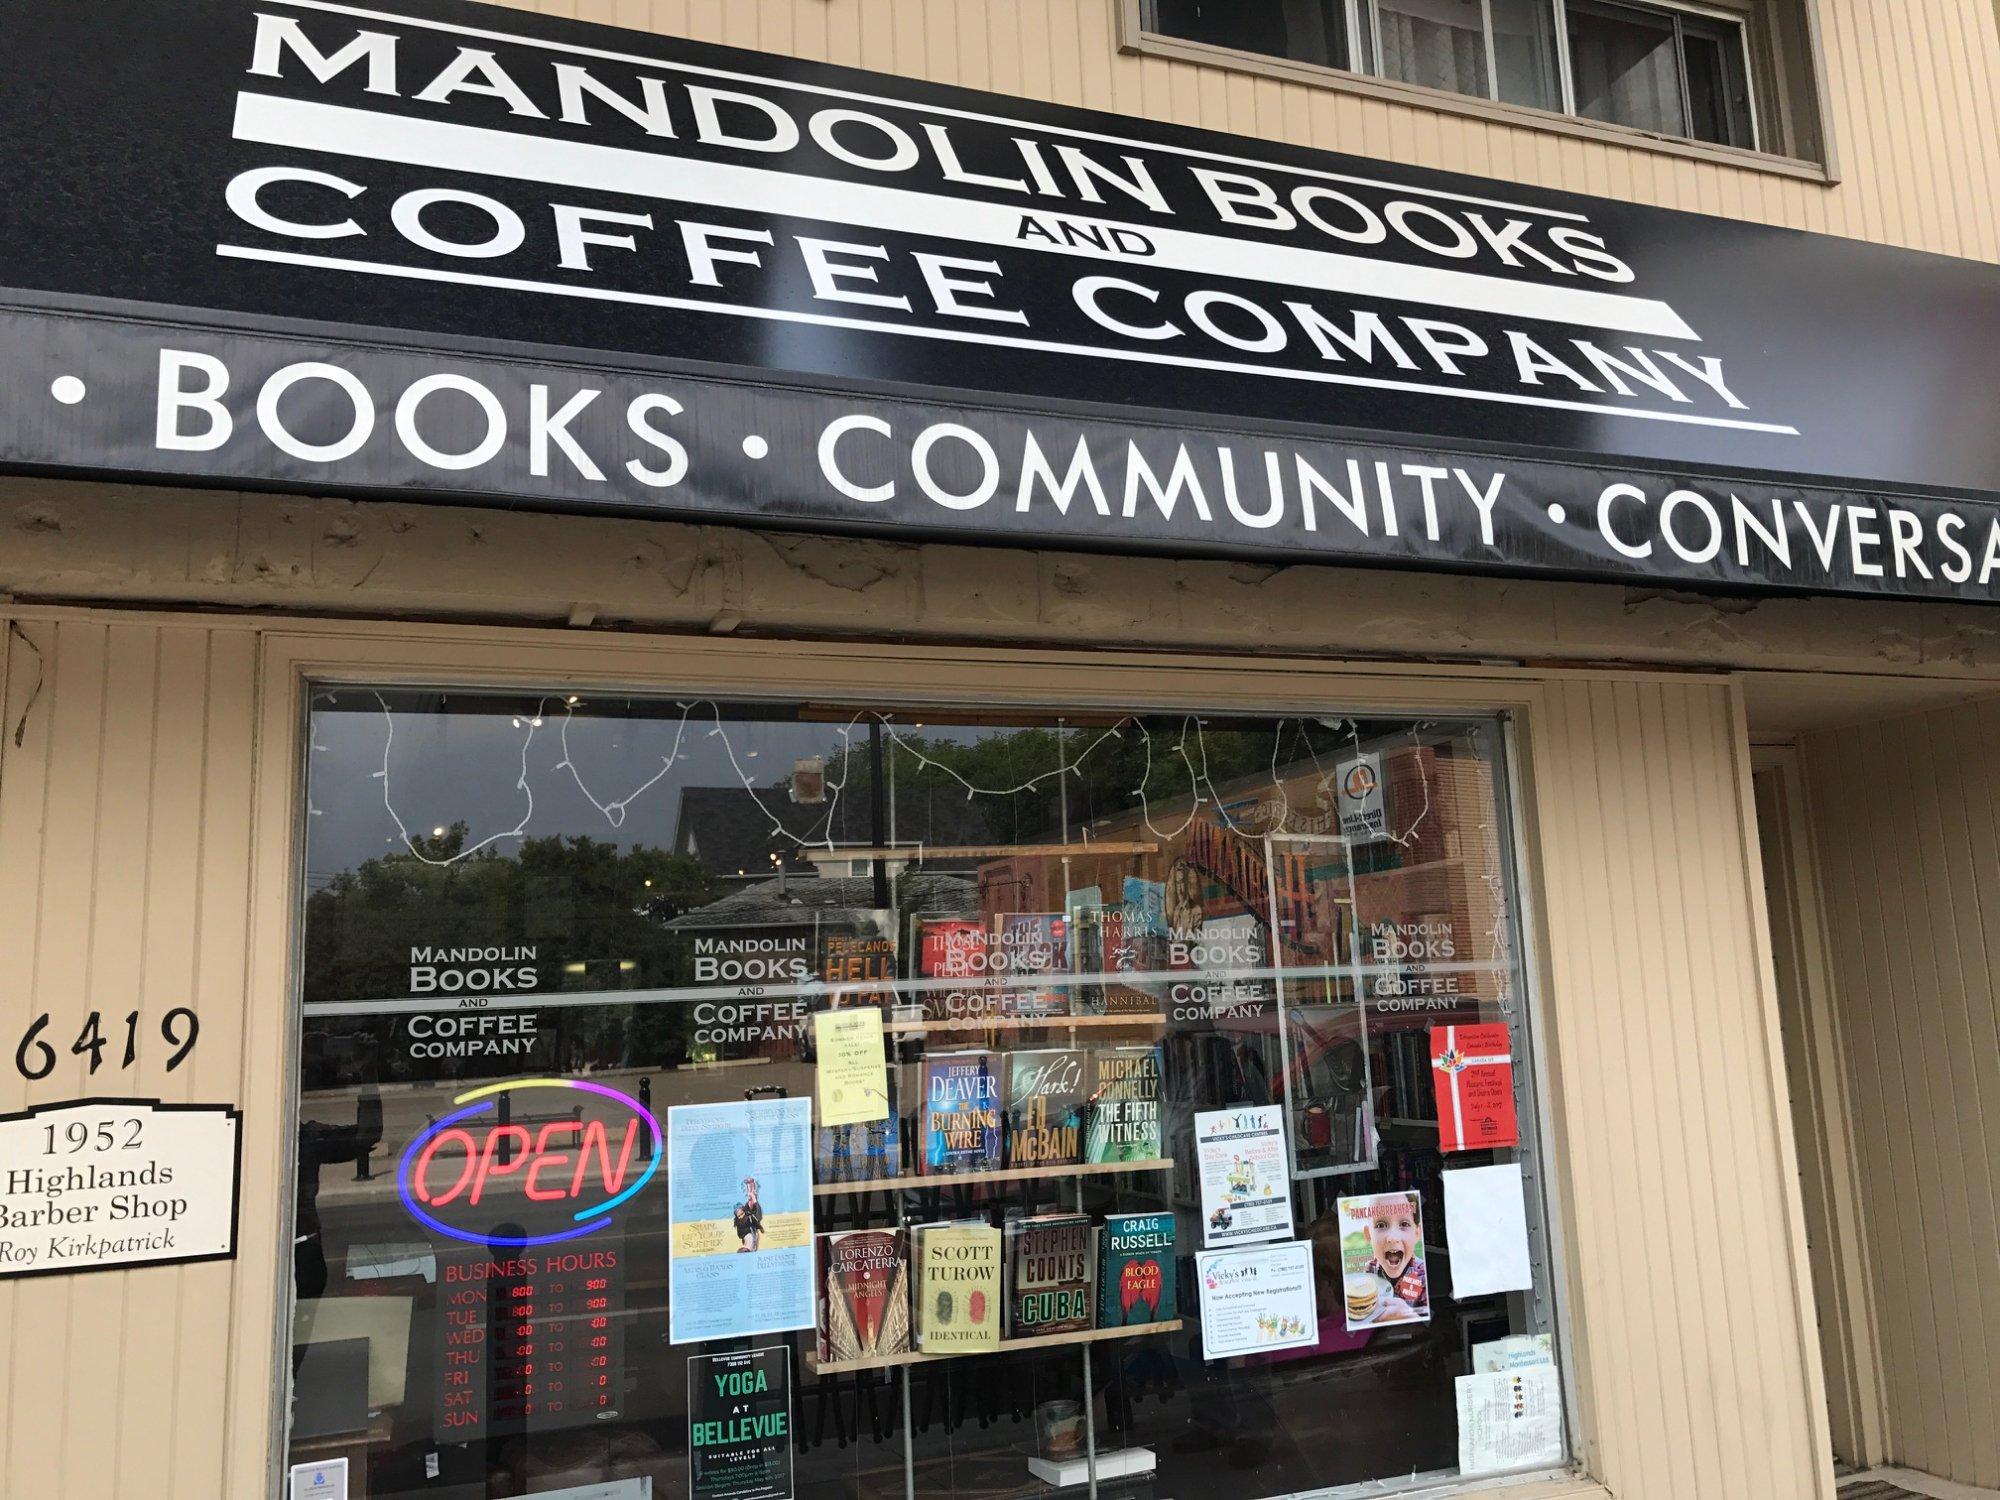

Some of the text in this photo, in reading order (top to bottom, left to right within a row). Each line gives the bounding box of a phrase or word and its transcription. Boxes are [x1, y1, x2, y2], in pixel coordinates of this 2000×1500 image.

[246, 13, 1635, 285] MANDOLIN BOOKS
[1015, 213, 1158, 258] AND
[224, 166, 1750, 410] COFFEE COMPANY
[154, 347, 689, 488] BOOKS
[817, 414, 1507, 547] COMMUNITY
[1091, 911, 1153, 923] THOMAS
[945, 930, 1043, 945] MANDOLIN
[1100, 927, 1158, 938] HARRIS
[1168, 927, 1258, 941] MANDOLIN
[1371, 923, 1452, 937] MANDOLIN
[411, 946, 537, 963] MANDOLIN
[694, 938, 805, 954] MANDOLIN
[1170, 943, 1261, 965] BOOKS
[1372, 939, 1456, 960] BOOKS
[694, 957, 808, 982] BOOKS
[826, 957, 895, 982] HELL
[945, 950, 1048, 971] BOOKS
[410, 966, 538, 992] BOOKS
[984, 978, 1008, 986] AND
[1374, 977, 1459, 996] COFFEE
[738, 987, 764, 996] AND
[1091, 996, 1157, 1006] HANNIBAL
[1171, 984, 1264, 1004] COFFEE
[458, 998, 488, 1007] AND
[945, 992, 1049, 1012] COFFEE
[1377, 996, 1459, 1012] COMPANY
[693, 1002, 808, 1025] COFFEE
[1173, 1004, 1264, 1021] COMPANY
[408, 1014, 538, 1038] COFFEE
[694, 1025, 807, 1044] COMPANY
[16, 1007, 199, 1080] 6419
[409, 1038, 537, 1058] COMPANY
[949, 1065, 979, 1076] JEFFERY
[1099, 1058, 1158, 1080] MICHAEL
[931, 1075, 997, 1103] DEAVER
[1099, 1080, 1158, 1100] CONNELLY
[931, 1107, 996, 1132] BURNING
[1027, 1096, 1046, 1130] ED
[1098, 1101, 1157, 1123] THE FIFTH
[42, 1118, 143, 1155] 1952
[945, 1129, 982, 1150] WIRE
[1099, 1121, 1157, 1143] WITNESS
[1011, 1128, 1079, 1163] McBAIN
[414, 1118, 640, 1207] OPEN
[5, 1160, 174, 1198] Highlands
[109, 1194, 187, 1221] Shop
[1350, 1206, 1379, 1220] PANCAKE
[1123, 1218, 1159, 1232] CRAIG
[0, 1227, 176, 1265] Roy Kirkpatrick
[1024, 1227, 1087, 1255] STEPHEN
[1111, 1233, 1172, 1250] RUSSELL
[840, 1244, 894, 1261] LORENZO
[931, 1246, 993, 1261] SCOTT
[445, 1251, 617, 1283] BUSINESS HOURS
[831, 1257, 902, 1274] CARCATERRA
[928, 1266, 995, 1281] TUROW
[1027, 1253, 1085, 1283] COONTS
[1125, 1265, 1159, 1277] BLOOD
[1212, 1268, 1239, 1280] Vicky's
[848, 1279, 887, 1292] MIDNIGHT
[853, 1287, 883, 1298] ANGELS
[1127, 1278, 1156, 1290] EAGLE
[447, 1289, 487, 1306] MON
[1225, 1291, 1252, 1299] Accepting
[1023, 1289, 1086, 1325] CUBA
[445, 1310, 477, 1326] TUE
[445, 1328, 486, 1345] WED
[930, 1331, 991, 1341] IDENTICAL
[445, 1350, 481, 1366] THU
[444, 1371, 469, 1386] FRI
[715, 1369, 768, 1397] YOGA
[444, 1391, 473, 1407] SAT
[732, 1405, 749, 1414] AT
[442, 1411, 478, 1429] SUN
[692, 1412, 787, 1447] BELLEVUE
